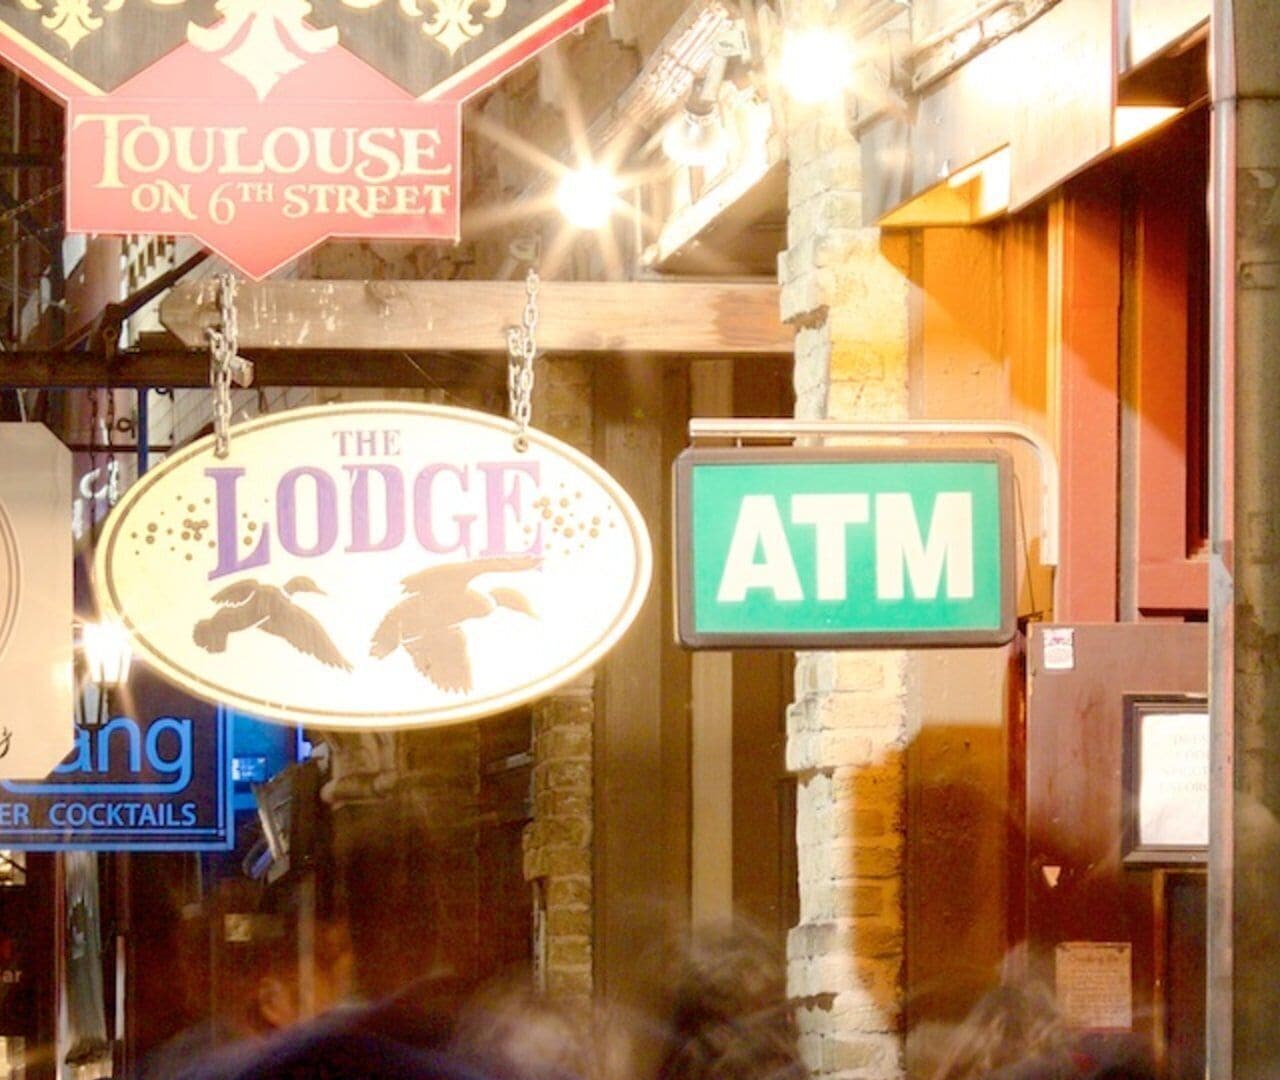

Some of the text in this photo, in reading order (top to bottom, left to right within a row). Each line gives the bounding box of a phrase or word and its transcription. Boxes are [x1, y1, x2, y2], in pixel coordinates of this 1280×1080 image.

[72, 113, 453, 189] TOULOUSE
[131, 178, 451, 225] ON 6TH STREET
[332, 429, 401, 457] THE
[204, 461, 544, 582] LODGE
[717, 492, 974, 601] ATM
[48, 801, 197, 828] COCKTAILS
